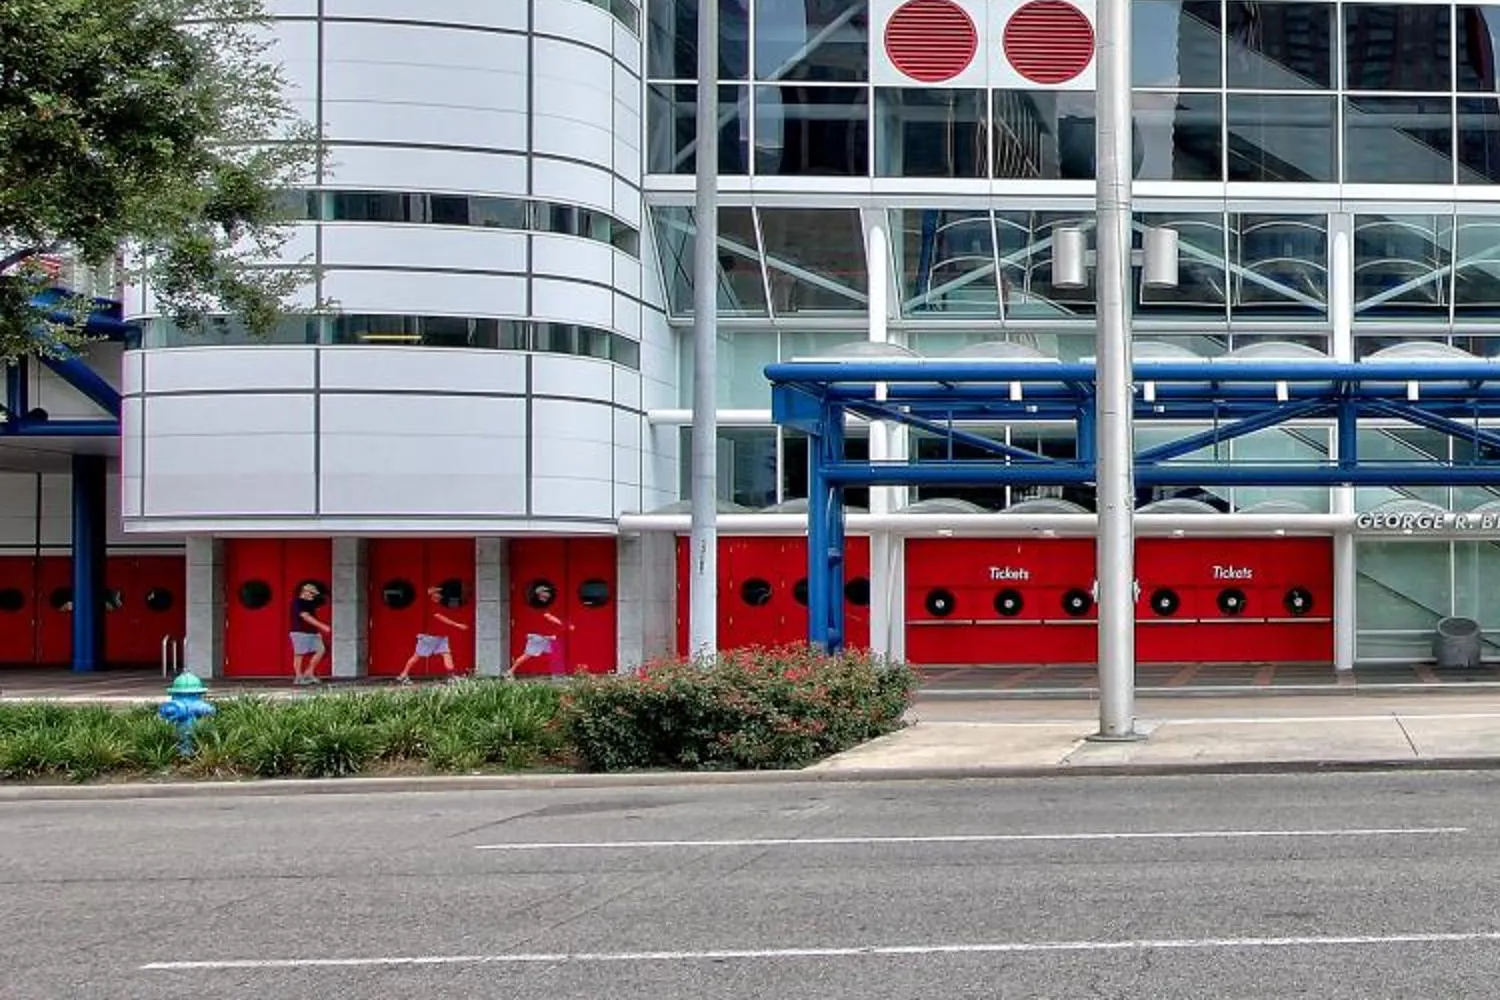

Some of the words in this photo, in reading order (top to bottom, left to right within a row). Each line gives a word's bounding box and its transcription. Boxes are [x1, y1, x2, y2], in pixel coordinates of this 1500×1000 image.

[1357, 513, 1445, 530] GEORGE
[1455, 513, 1474, 530] R.
[989, 566, 1029, 581] Tickets
[1212, 565, 1253, 580] Tickets
